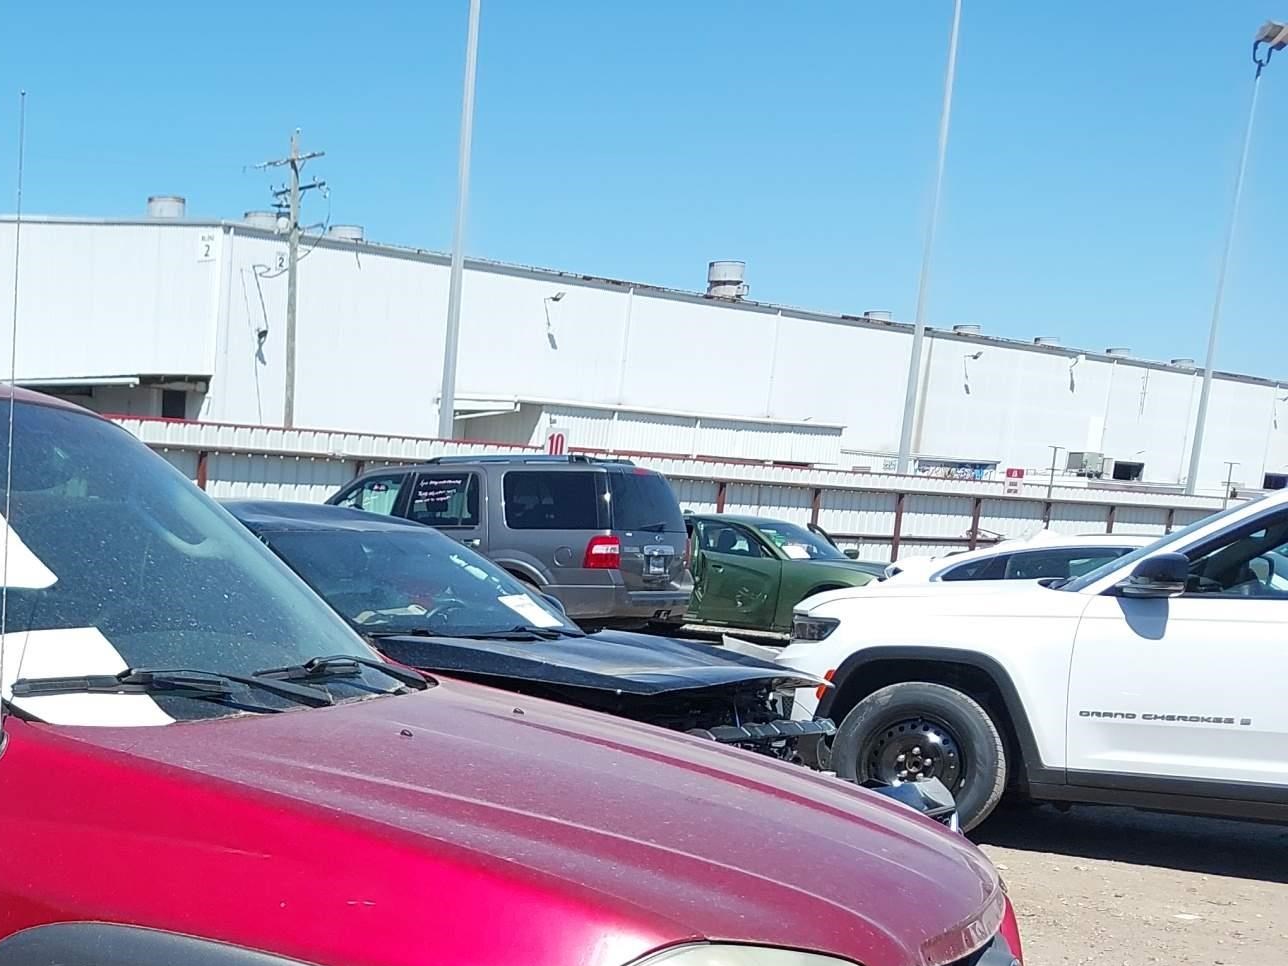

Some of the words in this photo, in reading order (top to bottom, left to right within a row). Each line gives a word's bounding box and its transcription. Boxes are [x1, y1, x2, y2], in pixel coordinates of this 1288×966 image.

[203, 243, 211, 257] 2
[548, 433, 564, 456] 10
[1079, 710, 1137, 720] GRAND
[1142, 713, 1235, 725] CHEROKEE
